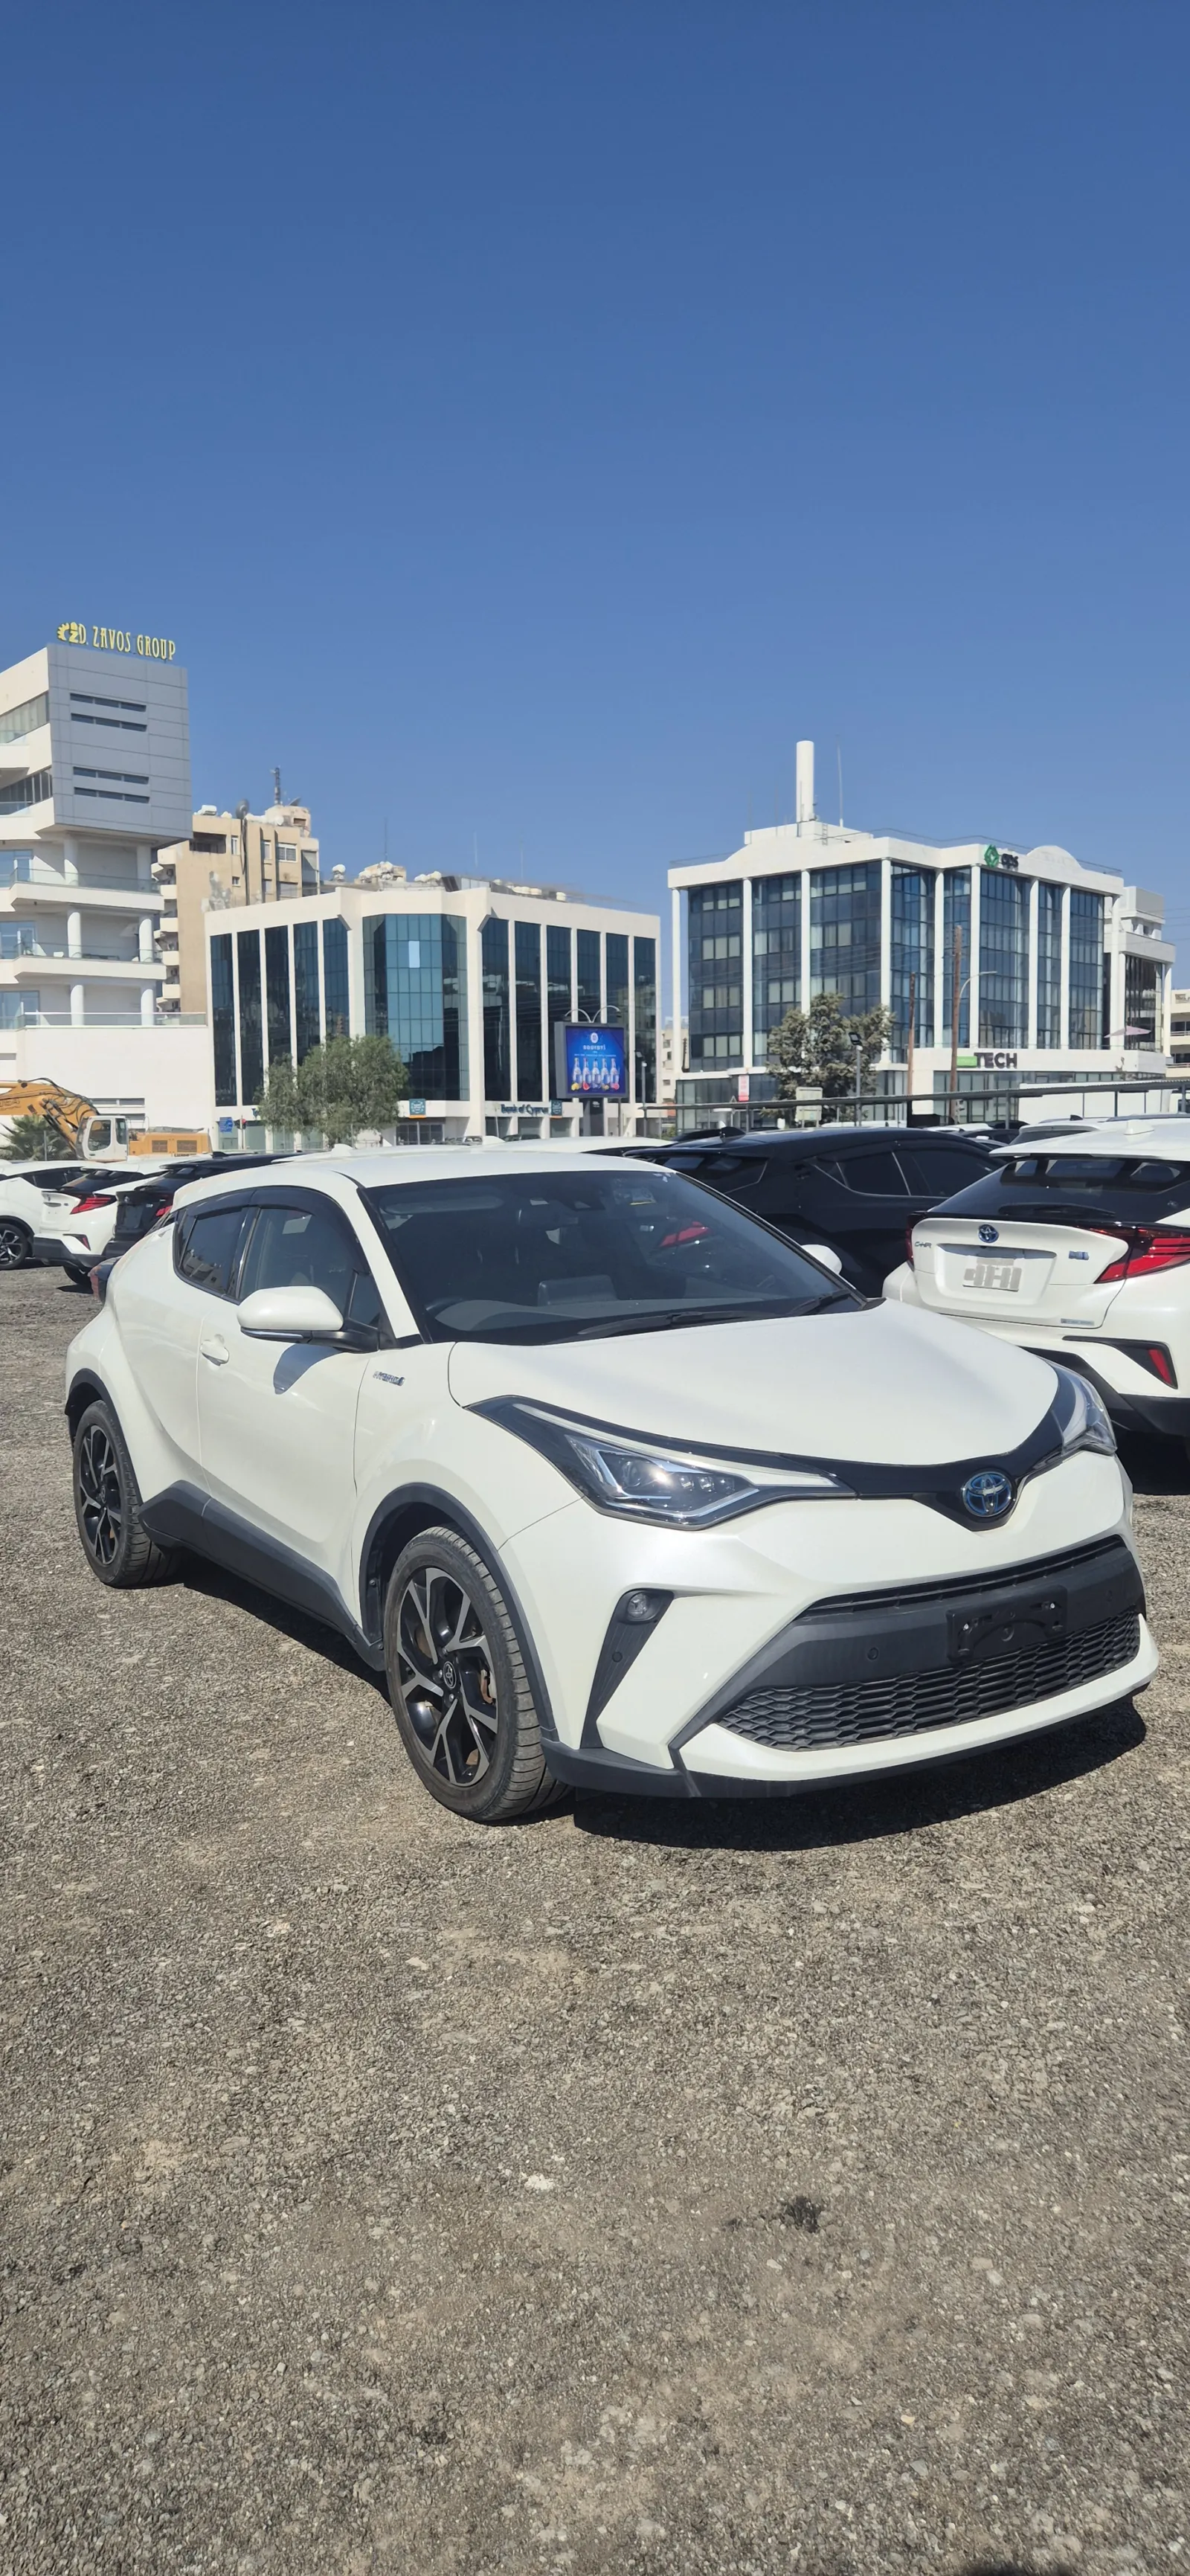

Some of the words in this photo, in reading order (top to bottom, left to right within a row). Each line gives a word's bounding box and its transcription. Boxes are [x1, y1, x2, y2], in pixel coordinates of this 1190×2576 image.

[92, 626, 132, 653] ZAVOS
[136, 634, 176, 661] GROUP
[974, 1052, 1017, 1069] TECH
